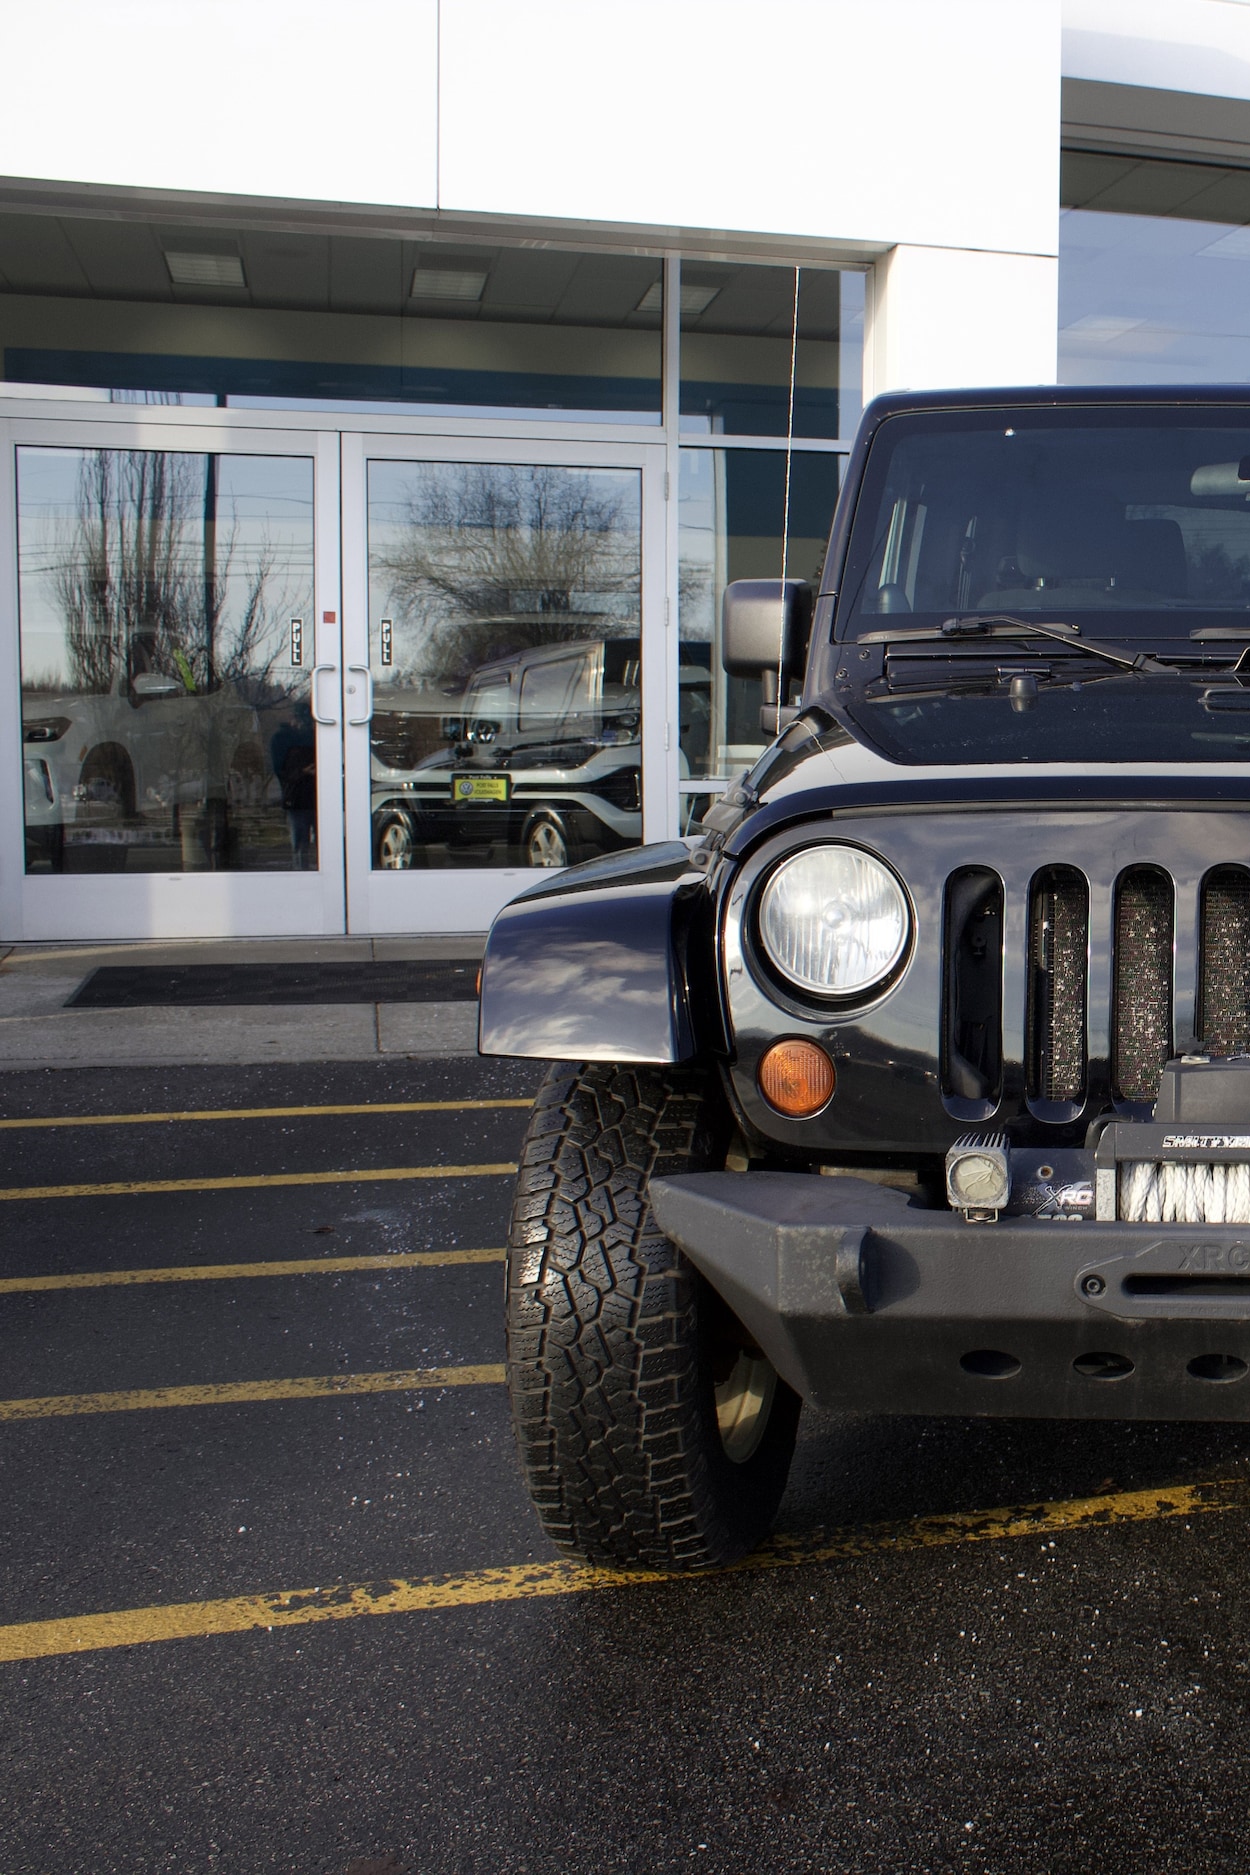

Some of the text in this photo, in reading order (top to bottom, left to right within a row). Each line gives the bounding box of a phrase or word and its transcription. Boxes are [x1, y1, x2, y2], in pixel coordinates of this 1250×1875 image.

[292, 623, 300, 662] PULL
[382, 623, 391, 662] PULL
[1032, 1184, 1094, 1216] XRC
[1178, 1243, 1250, 1272] XRC
